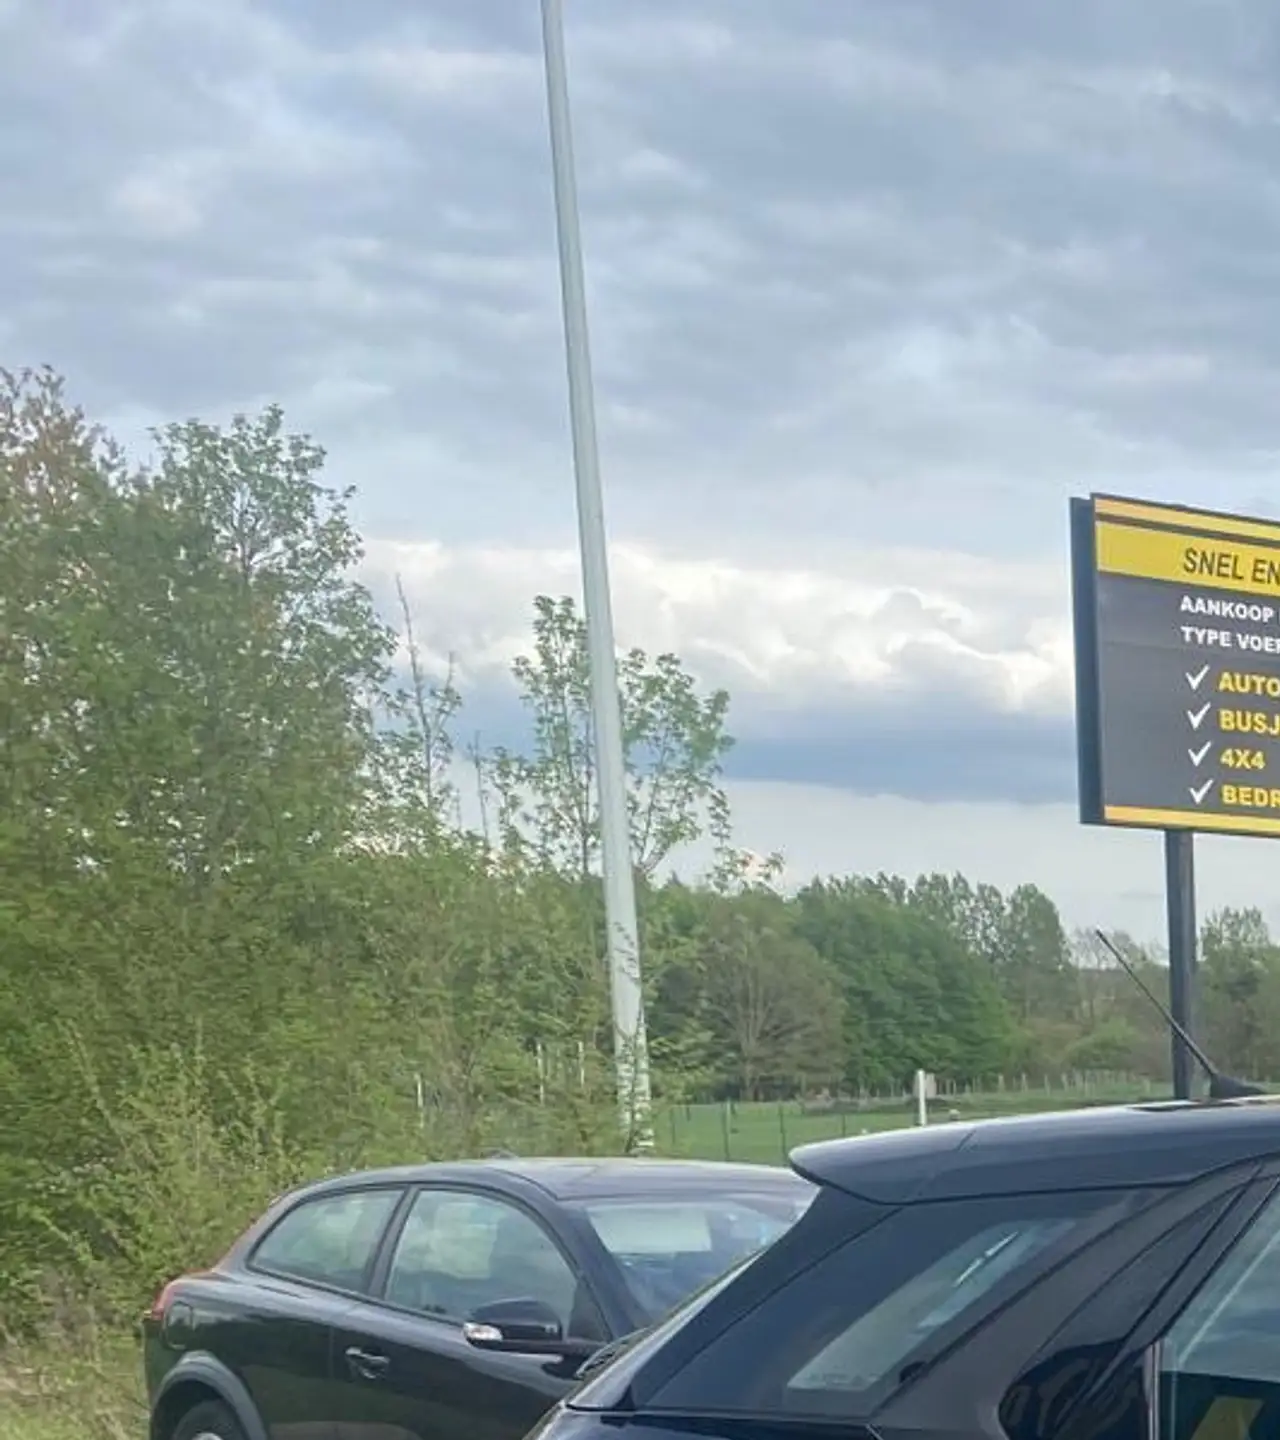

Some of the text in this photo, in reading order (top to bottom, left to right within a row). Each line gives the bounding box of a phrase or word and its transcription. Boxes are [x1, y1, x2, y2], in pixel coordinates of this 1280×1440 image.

[1183, 547, 1245, 580] SNEL
[1179, 595, 1274, 622] AANKOOP
[1180, 625, 1232, 648] TYPE
[1219, 747, 1267, 770] 4X4
